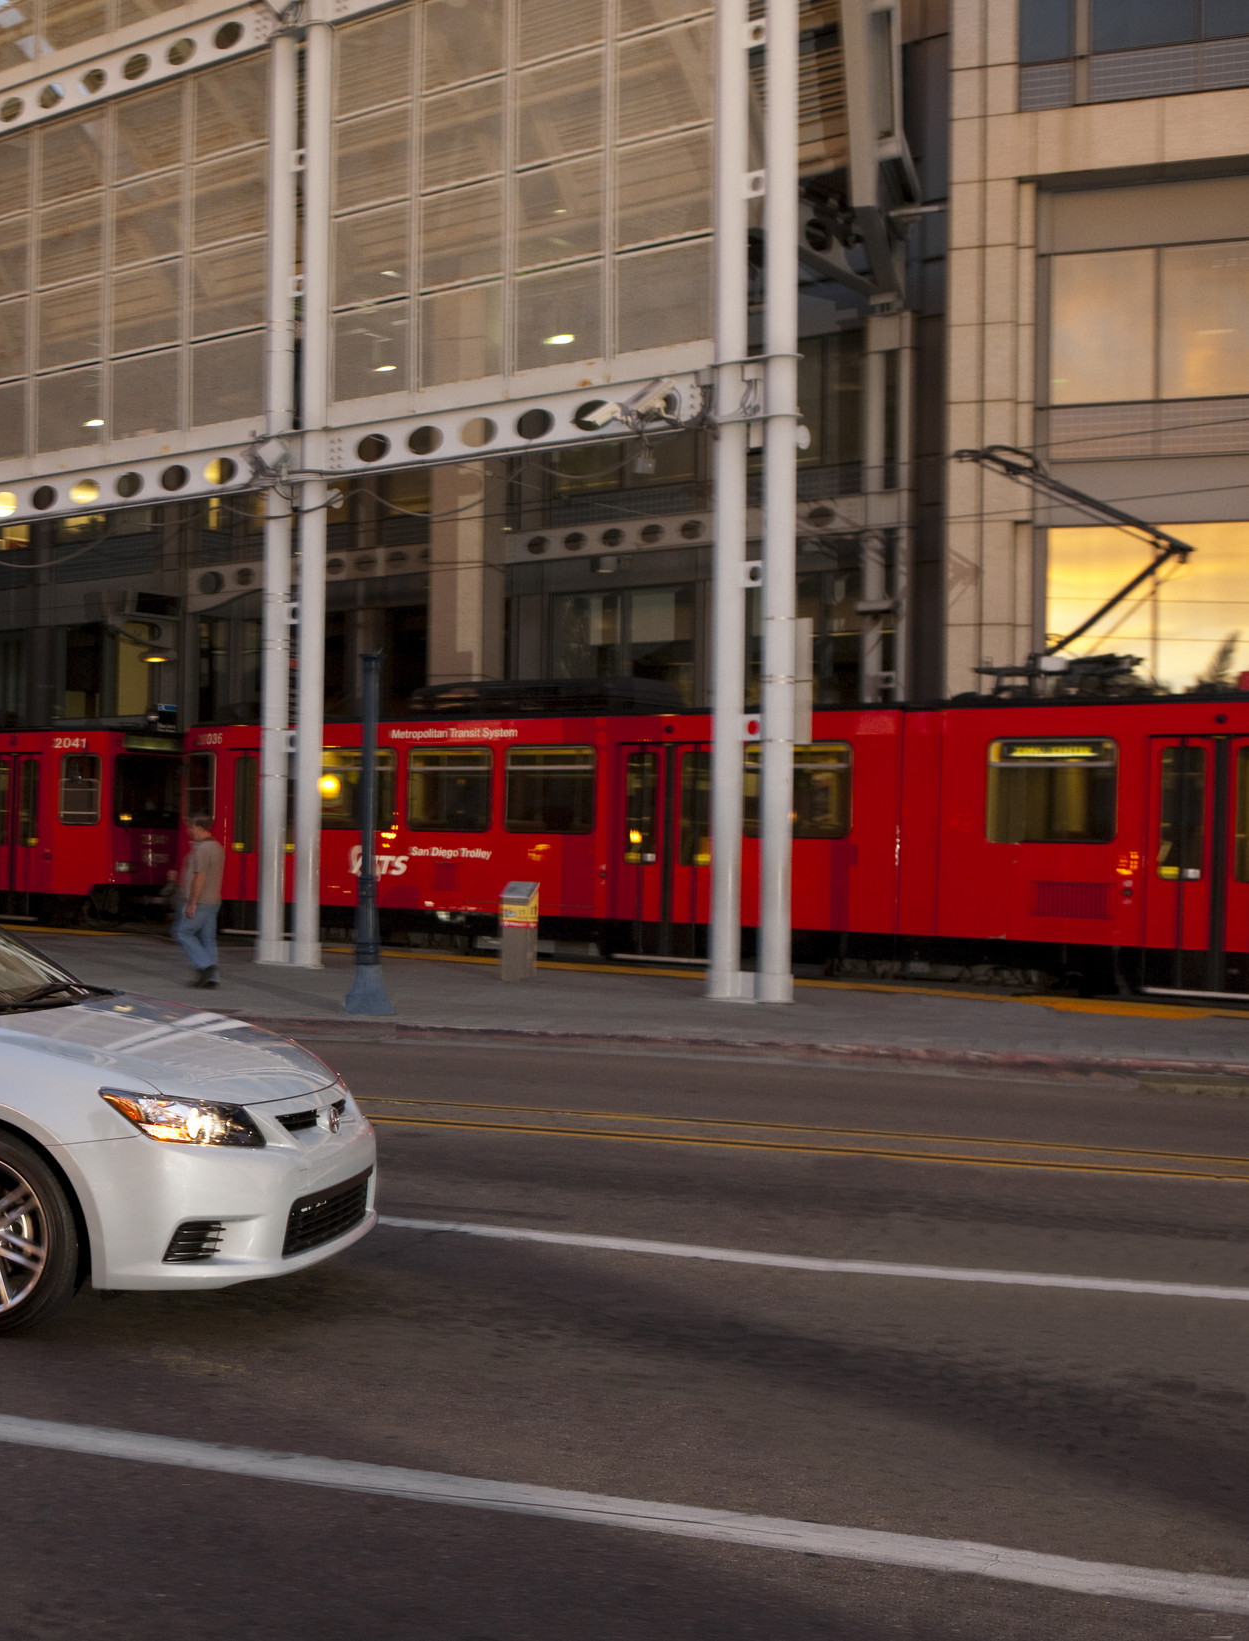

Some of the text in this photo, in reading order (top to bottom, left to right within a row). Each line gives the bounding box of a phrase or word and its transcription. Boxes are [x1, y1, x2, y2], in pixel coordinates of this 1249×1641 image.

[196, 732, 223, 745] 036
[390, 727, 518, 740] Metropolitan Transit System
[54, 737, 87, 749] 2041
[408, 846, 492, 860] San Diego Trolley
